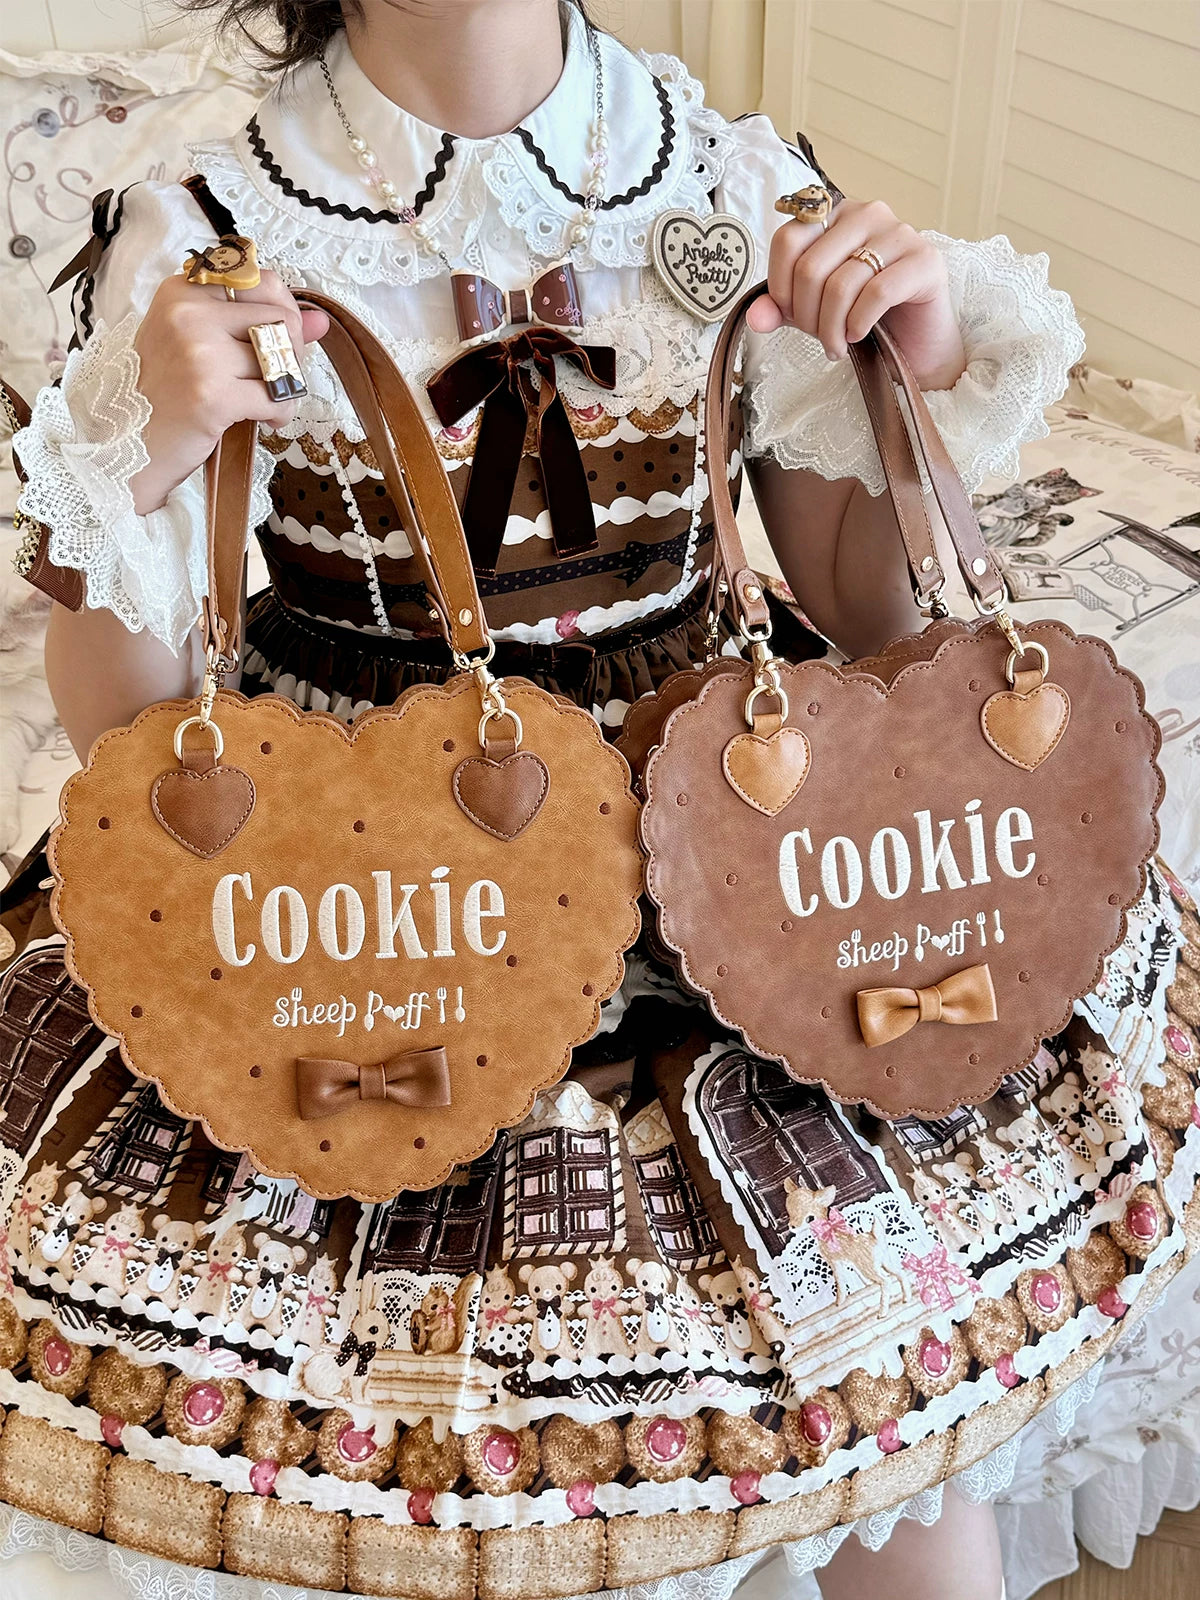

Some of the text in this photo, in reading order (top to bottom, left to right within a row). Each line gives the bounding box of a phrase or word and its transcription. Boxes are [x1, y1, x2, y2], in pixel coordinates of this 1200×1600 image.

[678, 242, 734, 267] Angelic
[685, 263, 732, 294] Pretty
[778, 798, 1036, 917] Cookie
[211, 865, 507, 967] Cookie
